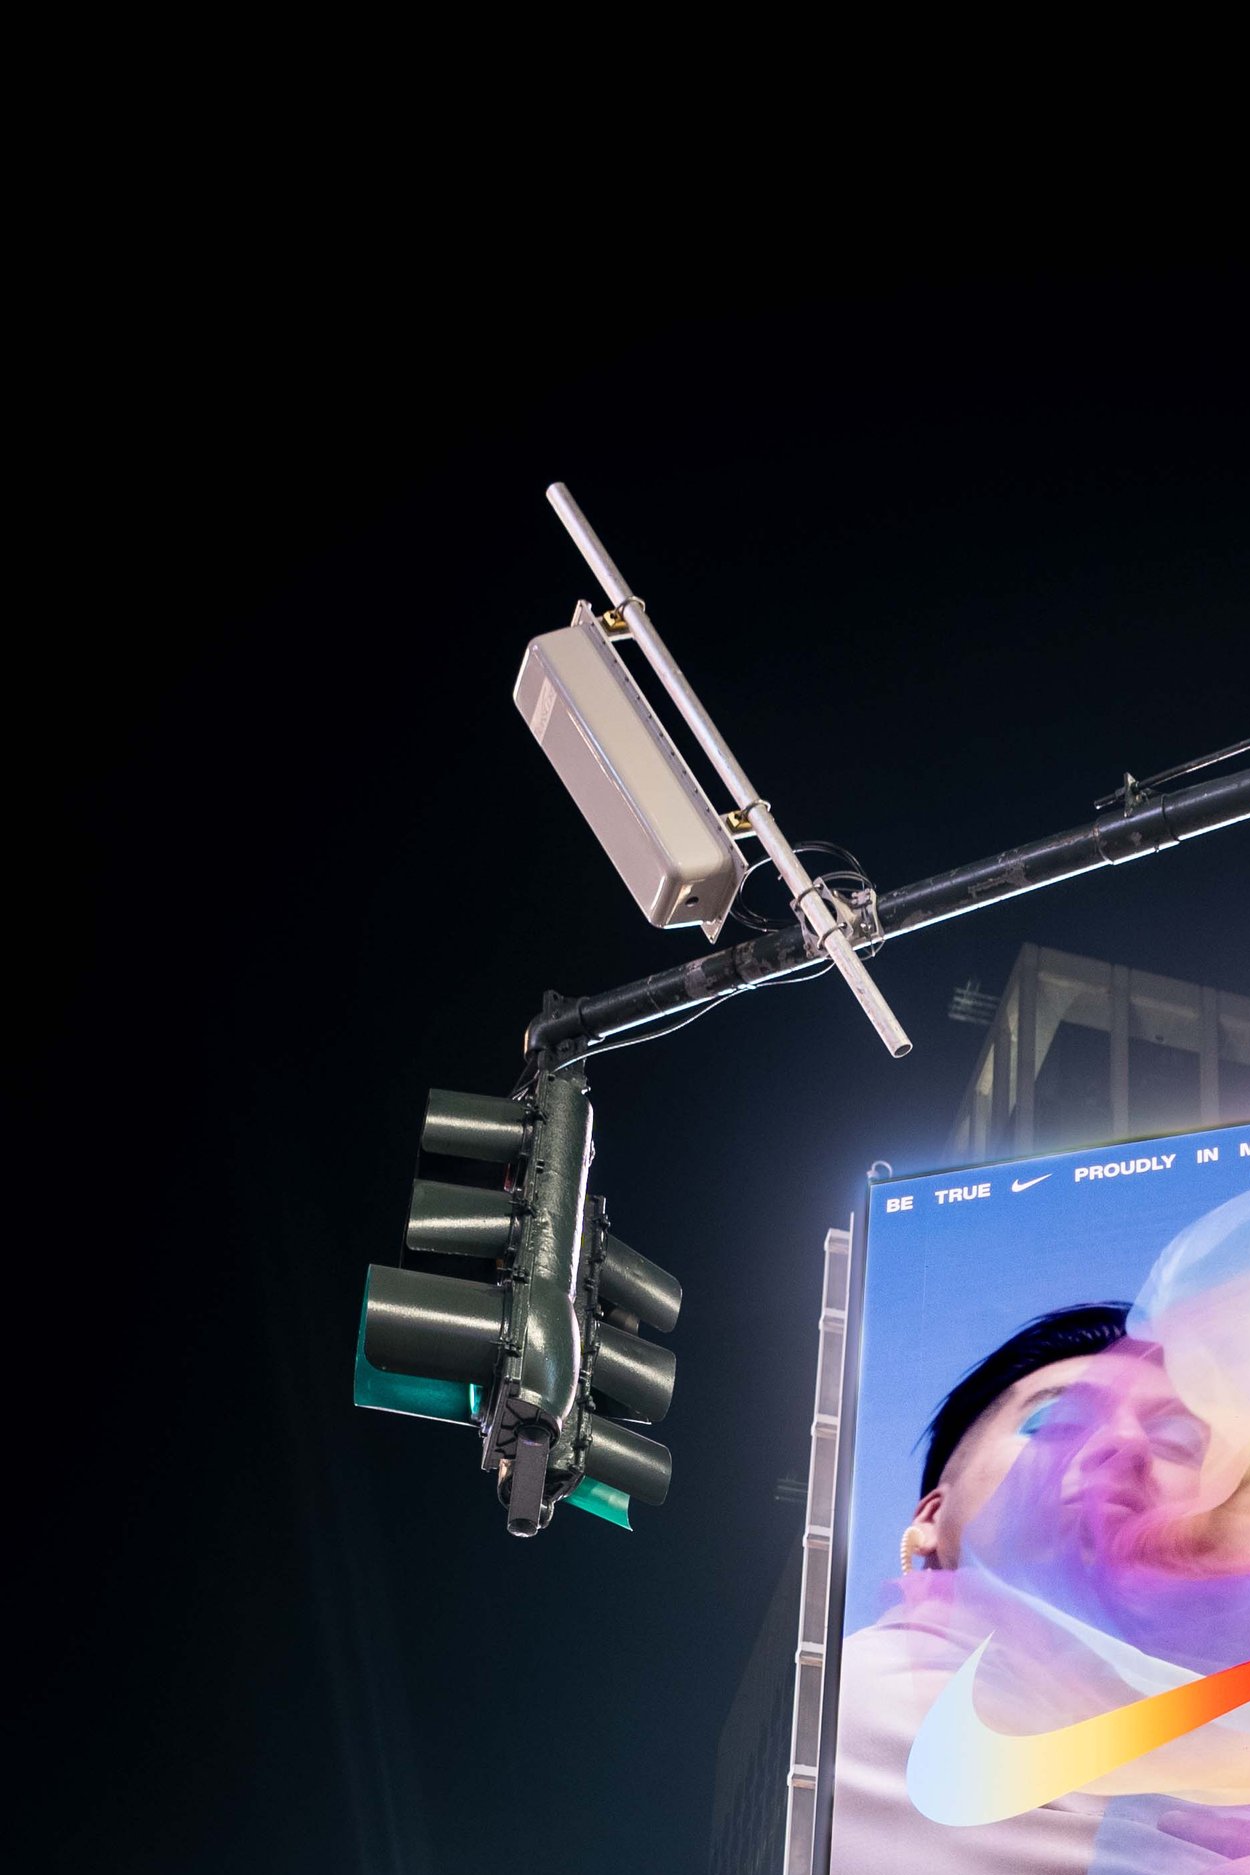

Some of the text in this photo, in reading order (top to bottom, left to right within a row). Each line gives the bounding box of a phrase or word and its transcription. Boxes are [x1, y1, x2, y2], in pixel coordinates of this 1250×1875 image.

[886, 1195, 914, 1214] BE
[935, 1183, 991, 1205] TRUE
[1074, 1153, 1177, 1183] PROUDLY
[1196, 1147, 1219, 1164] IN
